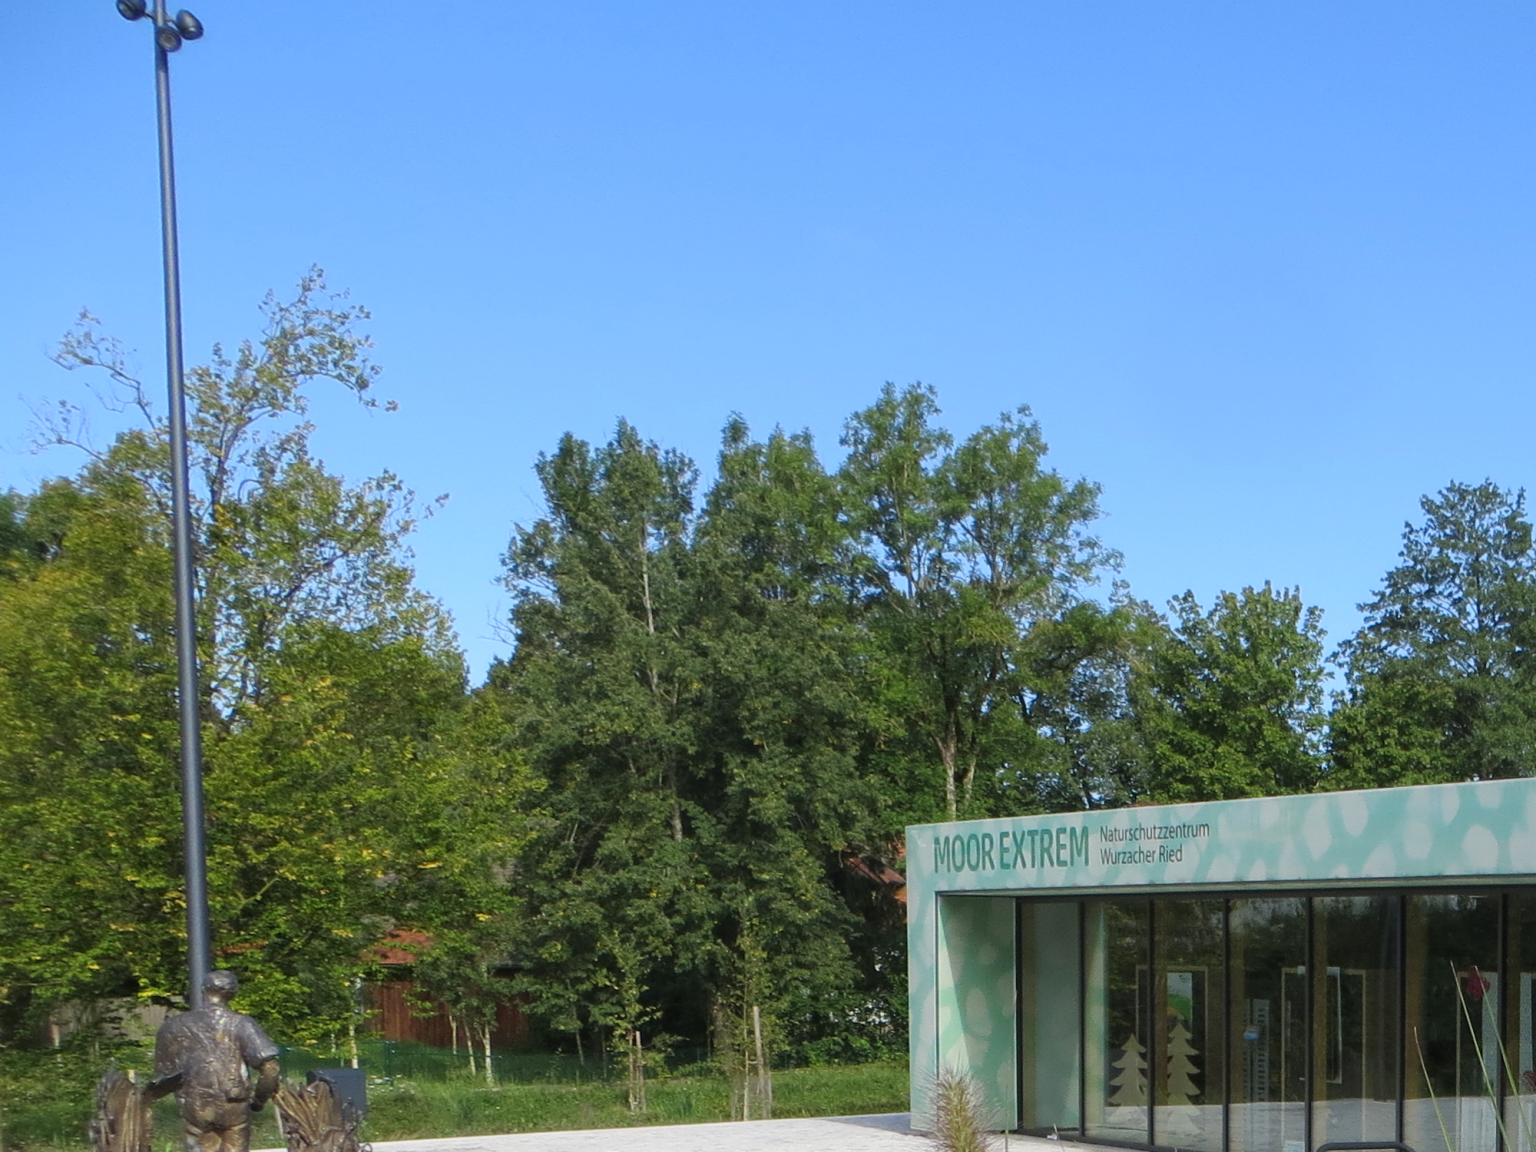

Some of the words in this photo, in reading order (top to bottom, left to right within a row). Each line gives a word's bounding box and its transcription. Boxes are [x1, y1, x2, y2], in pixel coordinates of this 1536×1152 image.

[1100, 822, 1210, 843] Naturschutzzentrum
[934, 834, 995, 874] MOOR
[1000, 826, 1090, 870] EXTREM
[1100, 847, 1156, 866] Wurzacher
[1158, 844, 1183, 864] Ried
